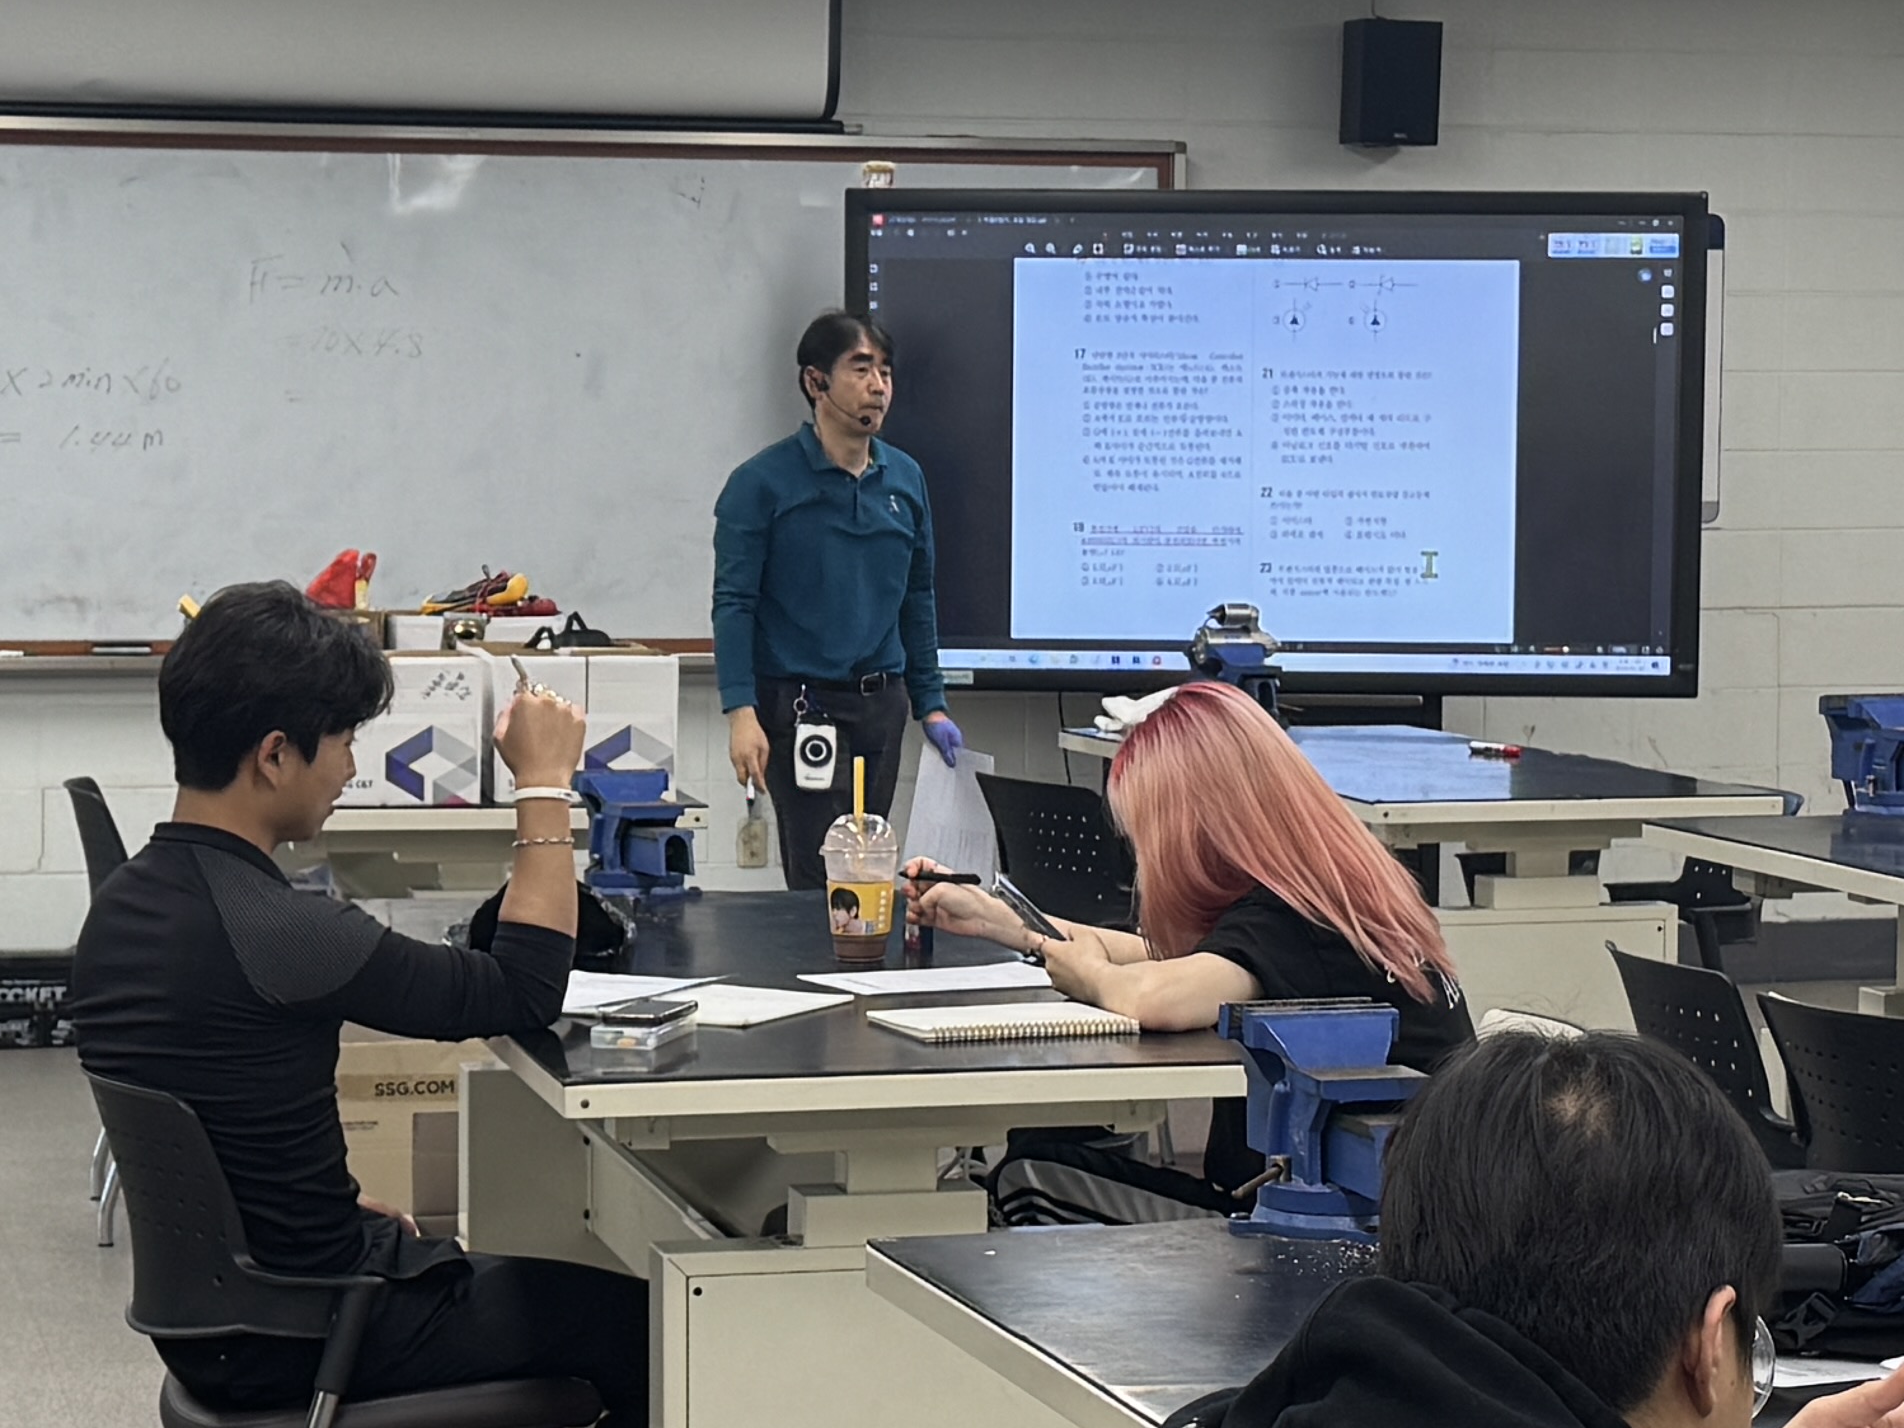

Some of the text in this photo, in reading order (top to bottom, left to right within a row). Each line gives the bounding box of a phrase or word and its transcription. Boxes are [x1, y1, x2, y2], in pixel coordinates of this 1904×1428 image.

[1074, 348, 1086, 359] 17
[1262, 368, 1273, 379] 21
[1260, 487, 1273, 498] 22
[374, 1078, 456, 1097] SSG.COM
